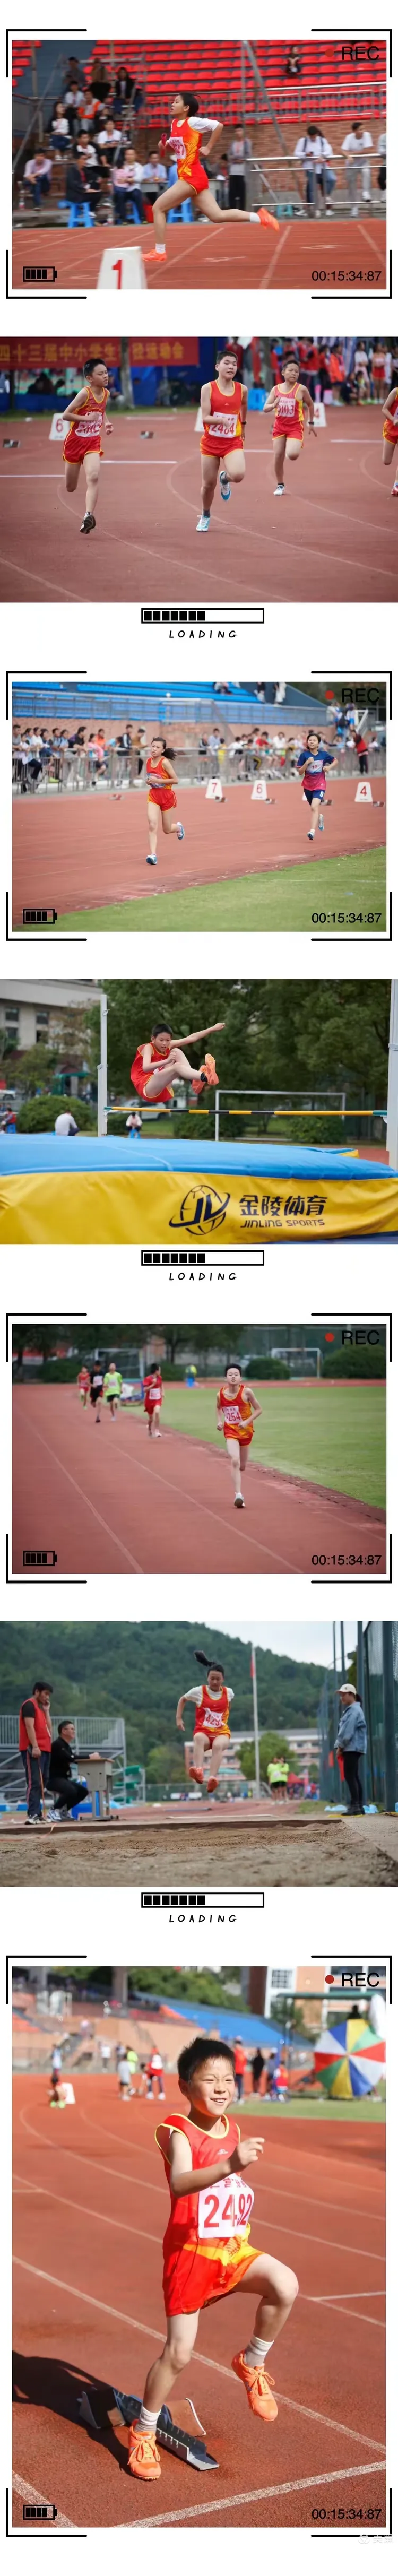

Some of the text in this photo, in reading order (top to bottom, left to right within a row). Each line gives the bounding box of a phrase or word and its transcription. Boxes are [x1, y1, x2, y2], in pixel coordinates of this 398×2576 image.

[112, 259, 123, 289] 1
[56, 418, 64, 433] 6
[212, 782, 218, 793] 7
[256, 783, 263, 794] 6
[360, 785, 367, 797] 4
[239, 1195, 328, 1216] 金陵体育
[204, 2194, 253, 2228] 2492
